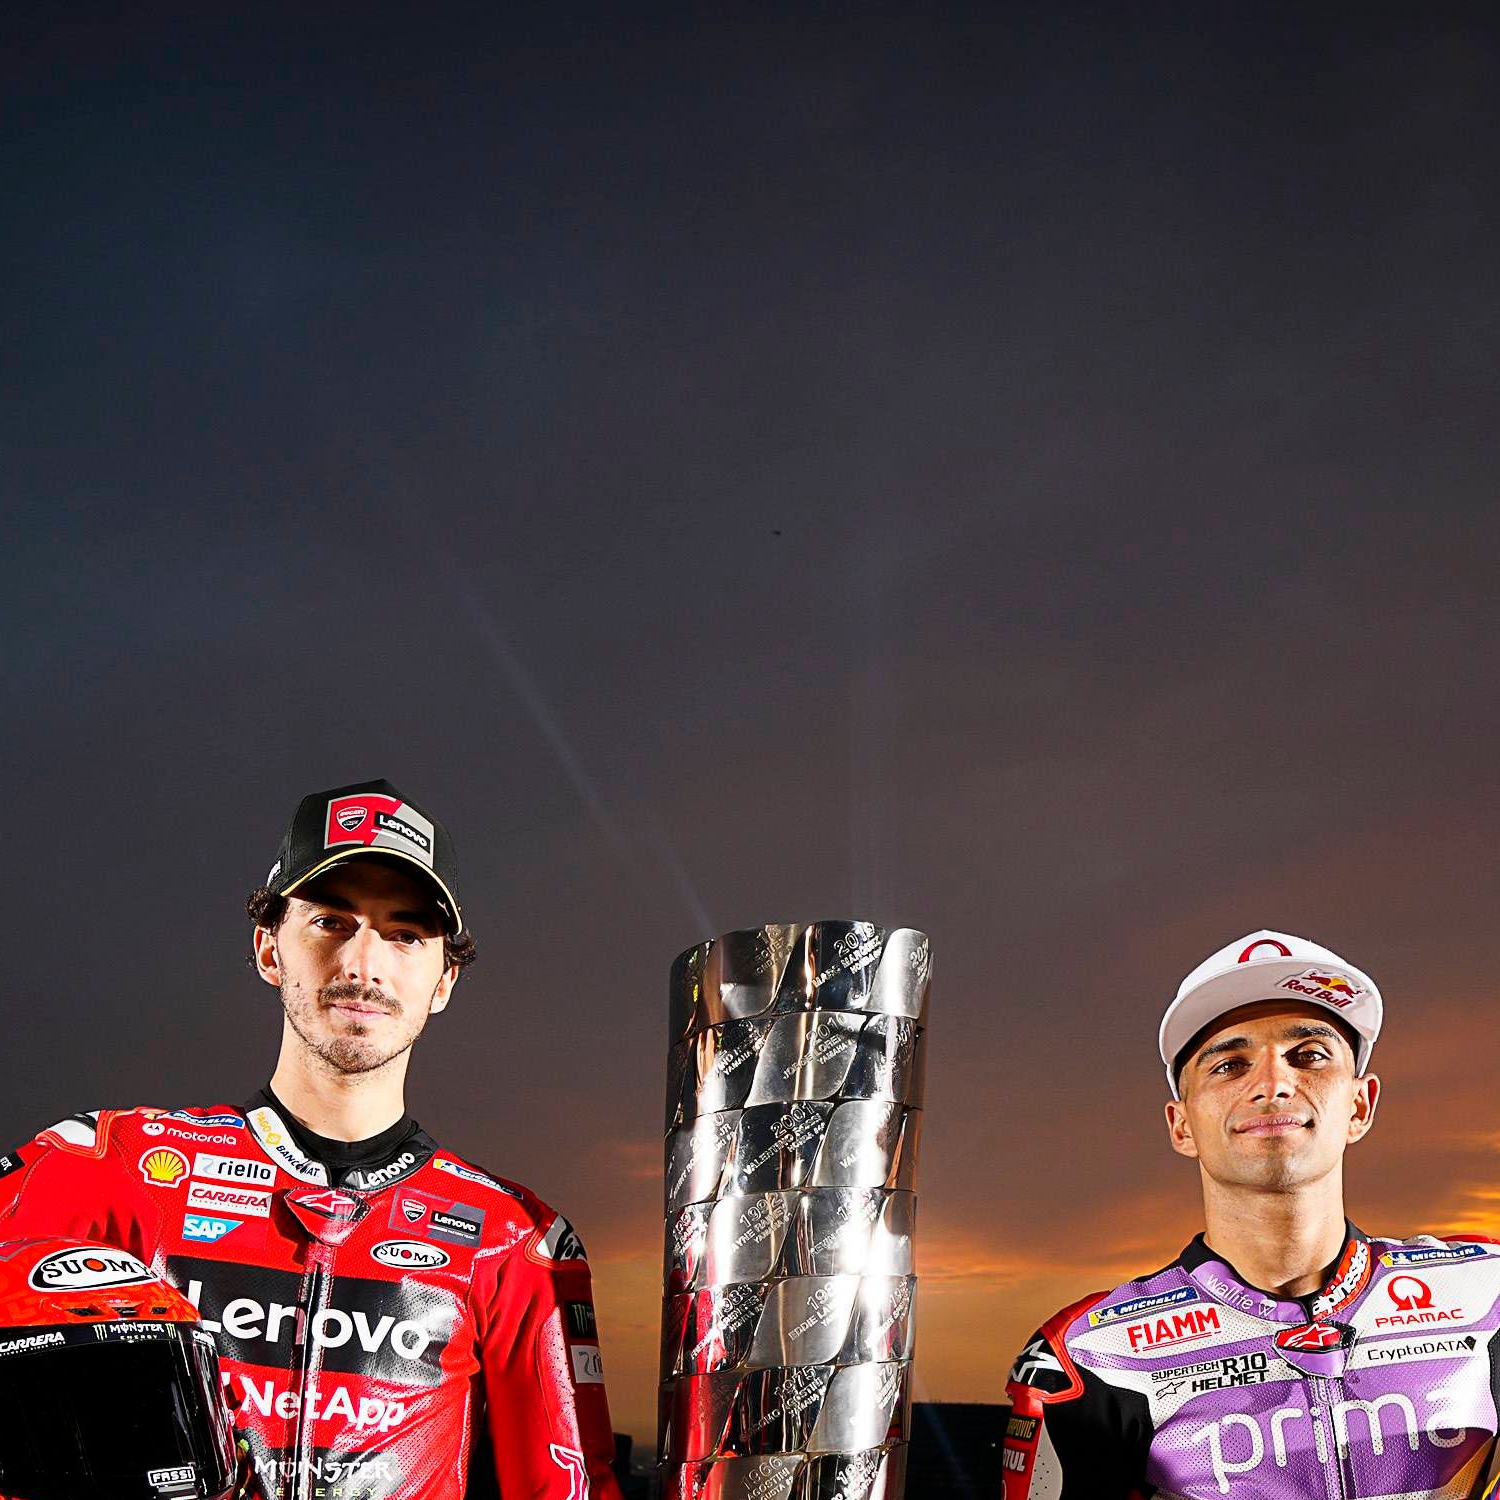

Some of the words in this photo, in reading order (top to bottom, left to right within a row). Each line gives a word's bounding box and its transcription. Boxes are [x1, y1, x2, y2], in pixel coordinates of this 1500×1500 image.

[339, 808, 365, 817] DUCATI
[380, 814, 428, 848] Lenovo
[1284, 979, 1316, 996] Red
[1315, 989, 1353, 1009] Bull
[770, 1101, 815, 1140] 2001
[167, 1126, 238, 1147] motorola
[743, 1131, 795, 1176] VALENTINO
[218, 1160, 272, 1181] riello
[357, 1152, 416, 1190] Lenovo
[192, 1188, 269, 1208] CARRERA
[184, 1219, 228, 1239] SAP
[434, 1212, 477, 1233] Lenovo
[380, 1246, 444, 1266] SUOMY
[1411, 1247, 1477, 1262] MICHELIN
[1120, 1290, 1190, 1315] MICHELIN
[1206, 1272, 1254, 1312] wallife
[110, 1322, 165, 1335] MONSTER
[188, 1279, 431, 1361] Lenovo
[788, 1316, 818, 1341] EDDIE
[1127, 1307, 1221, 1349] FIAMM
[1375, 1309, 1465, 1329] PRAMAC
[1368, 1339, 1468, 1361] CryptoDATA
[1151, 1361, 1220, 1382] SUPERTECH
[1220, 1353, 1269, 1377] R10
[773, 1365, 817, 1398] 1975
[1192, 1370, 1270, 1393] HELMET
[240, 1374, 406, 1434] NetApp
[1191, 1390, 1467, 1495] prima
[152, 1469, 193, 1483] FASSI
[254, 1456, 395, 1483] MONSTER
[742, 1455, 783, 1491] 1966
[276, 1486, 379, 1498] ENERGY
